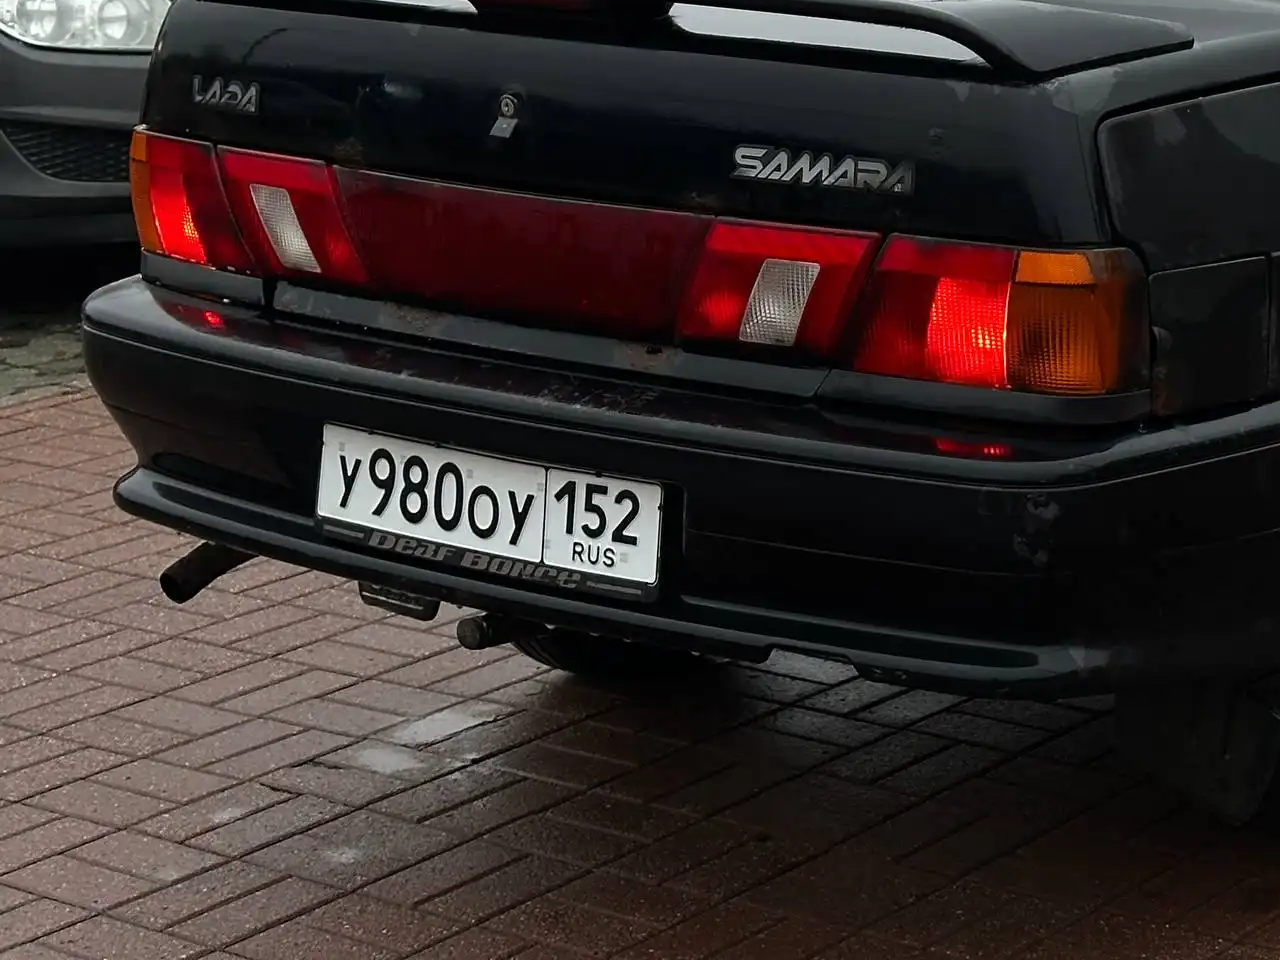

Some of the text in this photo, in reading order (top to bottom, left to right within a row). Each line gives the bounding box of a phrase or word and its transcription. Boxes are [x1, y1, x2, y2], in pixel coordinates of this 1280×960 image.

[192, 74, 260, 115] LADA
[732, 144, 915, 196] SAMARA
[553, 480, 641, 547] 152
[571, 541, 616, 568] RUS
